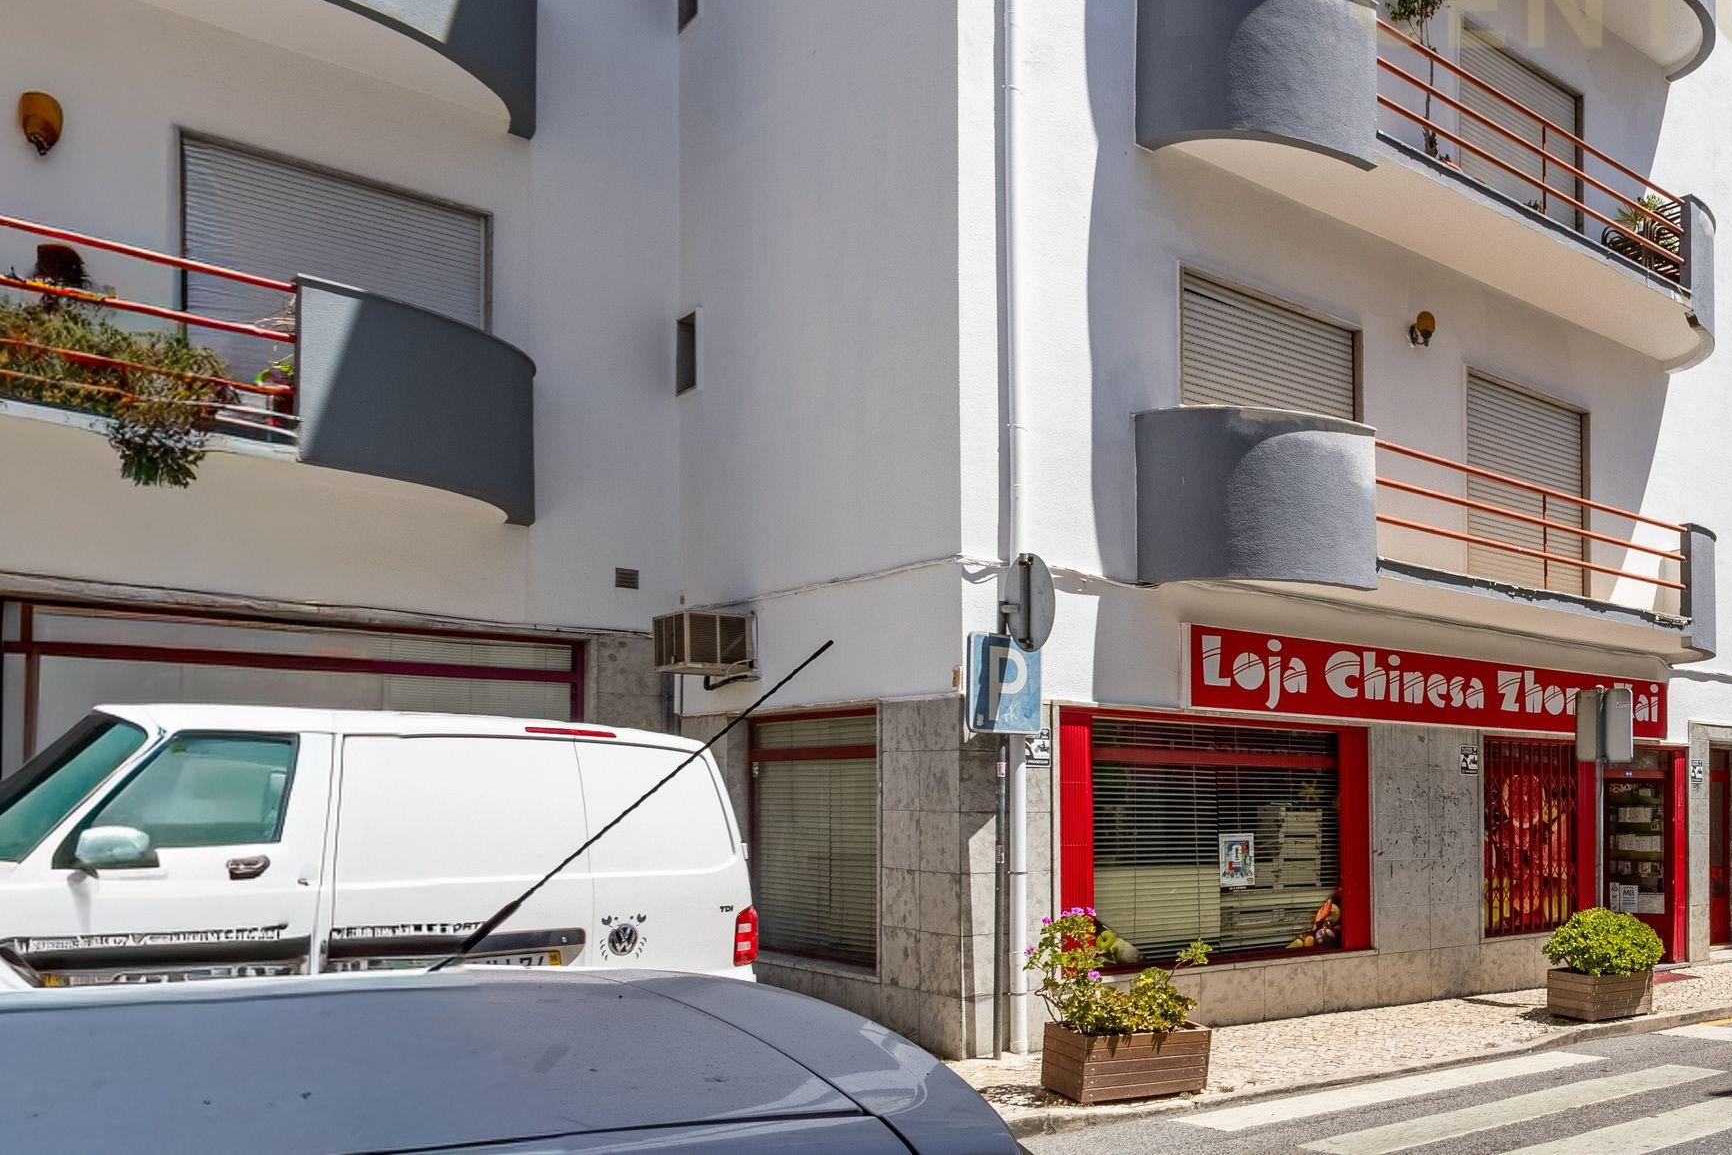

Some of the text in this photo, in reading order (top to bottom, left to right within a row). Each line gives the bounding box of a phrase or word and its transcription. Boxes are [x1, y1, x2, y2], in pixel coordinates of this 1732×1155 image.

[988, 645, 1028, 721] P
[1201, 634, 1308, 710] Loja
[1325, 650, 1484, 710] Chinesa
[1497, 670, 1578, 716] Zhon
[719, 905, 734, 913] TDI
